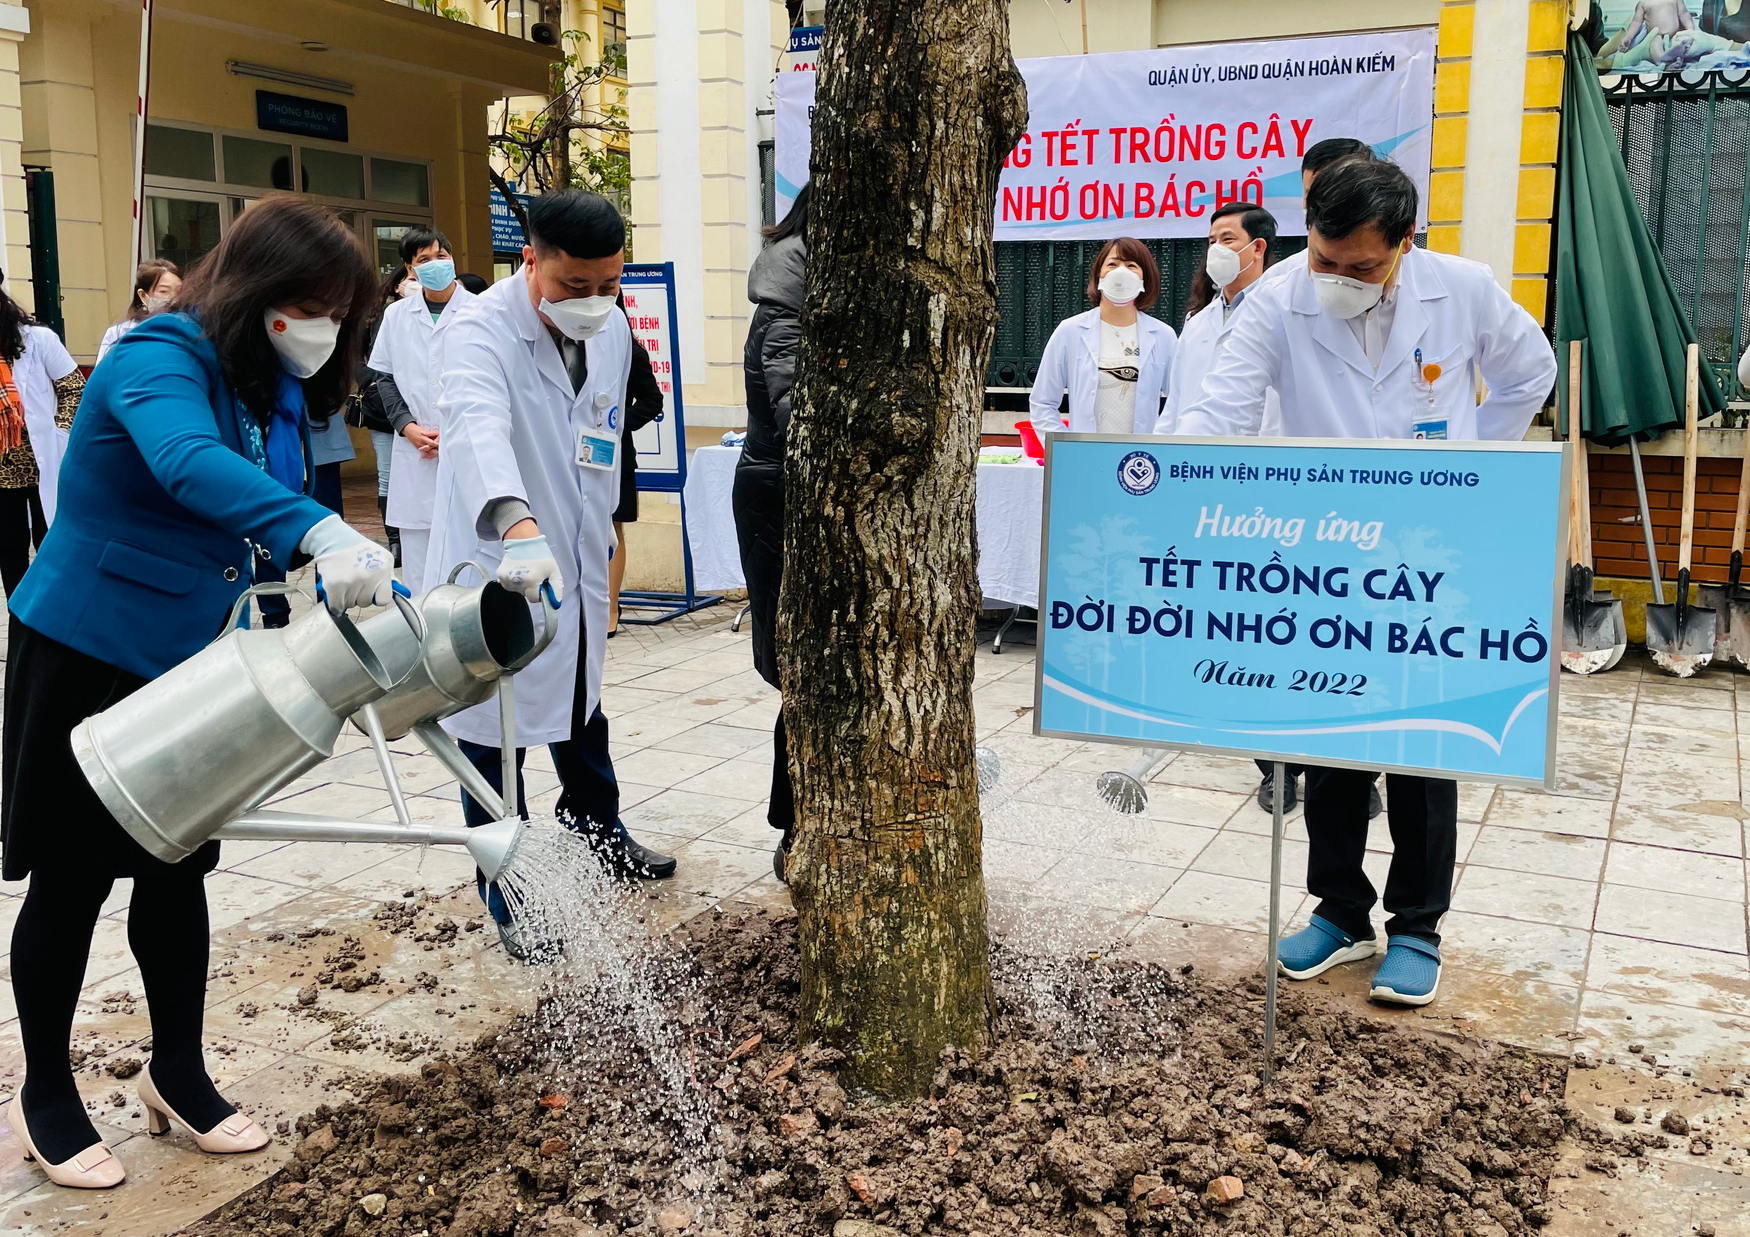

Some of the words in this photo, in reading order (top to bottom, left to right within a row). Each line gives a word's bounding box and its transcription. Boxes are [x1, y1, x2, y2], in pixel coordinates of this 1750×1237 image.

[801, 32, 822, 46] SẢN
[1148, 66, 1188, 88] QUẬN
[1192, 64, 1215, 84] ỦY,
[1218, 64, 1258, 82] UBND
[1262, 59, 1304, 80] QUẬN
[1308, 56, 1352, 76] HOÀN
[1356, 51, 1396, 73] KIẾM
[278, 118, 309, 129] SECURITY
[1003, 132, 1032, 168] G
[1042, 118, 1100, 166] TẾT
[1109, 112, 1226, 164] TRỒNG
[1236, 112, 1314, 159] CÂY
[1002, 176, 1070, 222] NHỚ
[1079, 180, 1124, 220] ƠN
[1134, 172, 1206, 218] BÁC
[1216, 166, 1263, 212] HỒ
[639, 314, 659, 332] BỆNH
[647, 339, 659, 354] TRỊ
[1170, 461, 1214, 482] BỆNH
[1220, 462, 1259, 484] VIỆN
[1266, 467, 1301, 486] PHỤ
[1307, 464, 1344, 483] SẢN
[1350, 470, 1414, 486] TRUNG
[1420, 470, 1480, 488] ƯƠNG
[1194, 504, 1306, 548] Hưởng
[1316, 511, 1384, 550] ứng
[1139, 545, 1202, 588] TẾT
[1212, 550, 1349, 598] TRỒNG
[1362, 562, 1446, 602] CÂY
[1050, 594, 1115, 633] ĐỜI
[1126, 600, 1194, 638] ĐỜI
[1207, 607, 1298, 646] NHỚ
[1310, 614, 1372, 652] ƠN
[1388, 616, 1465, 658] BÁC
[1480, 617, 1548, 664] HỒ
[1193, 658, 1278, 690] Năm
[1288, 669, 1368, 696] 2022
